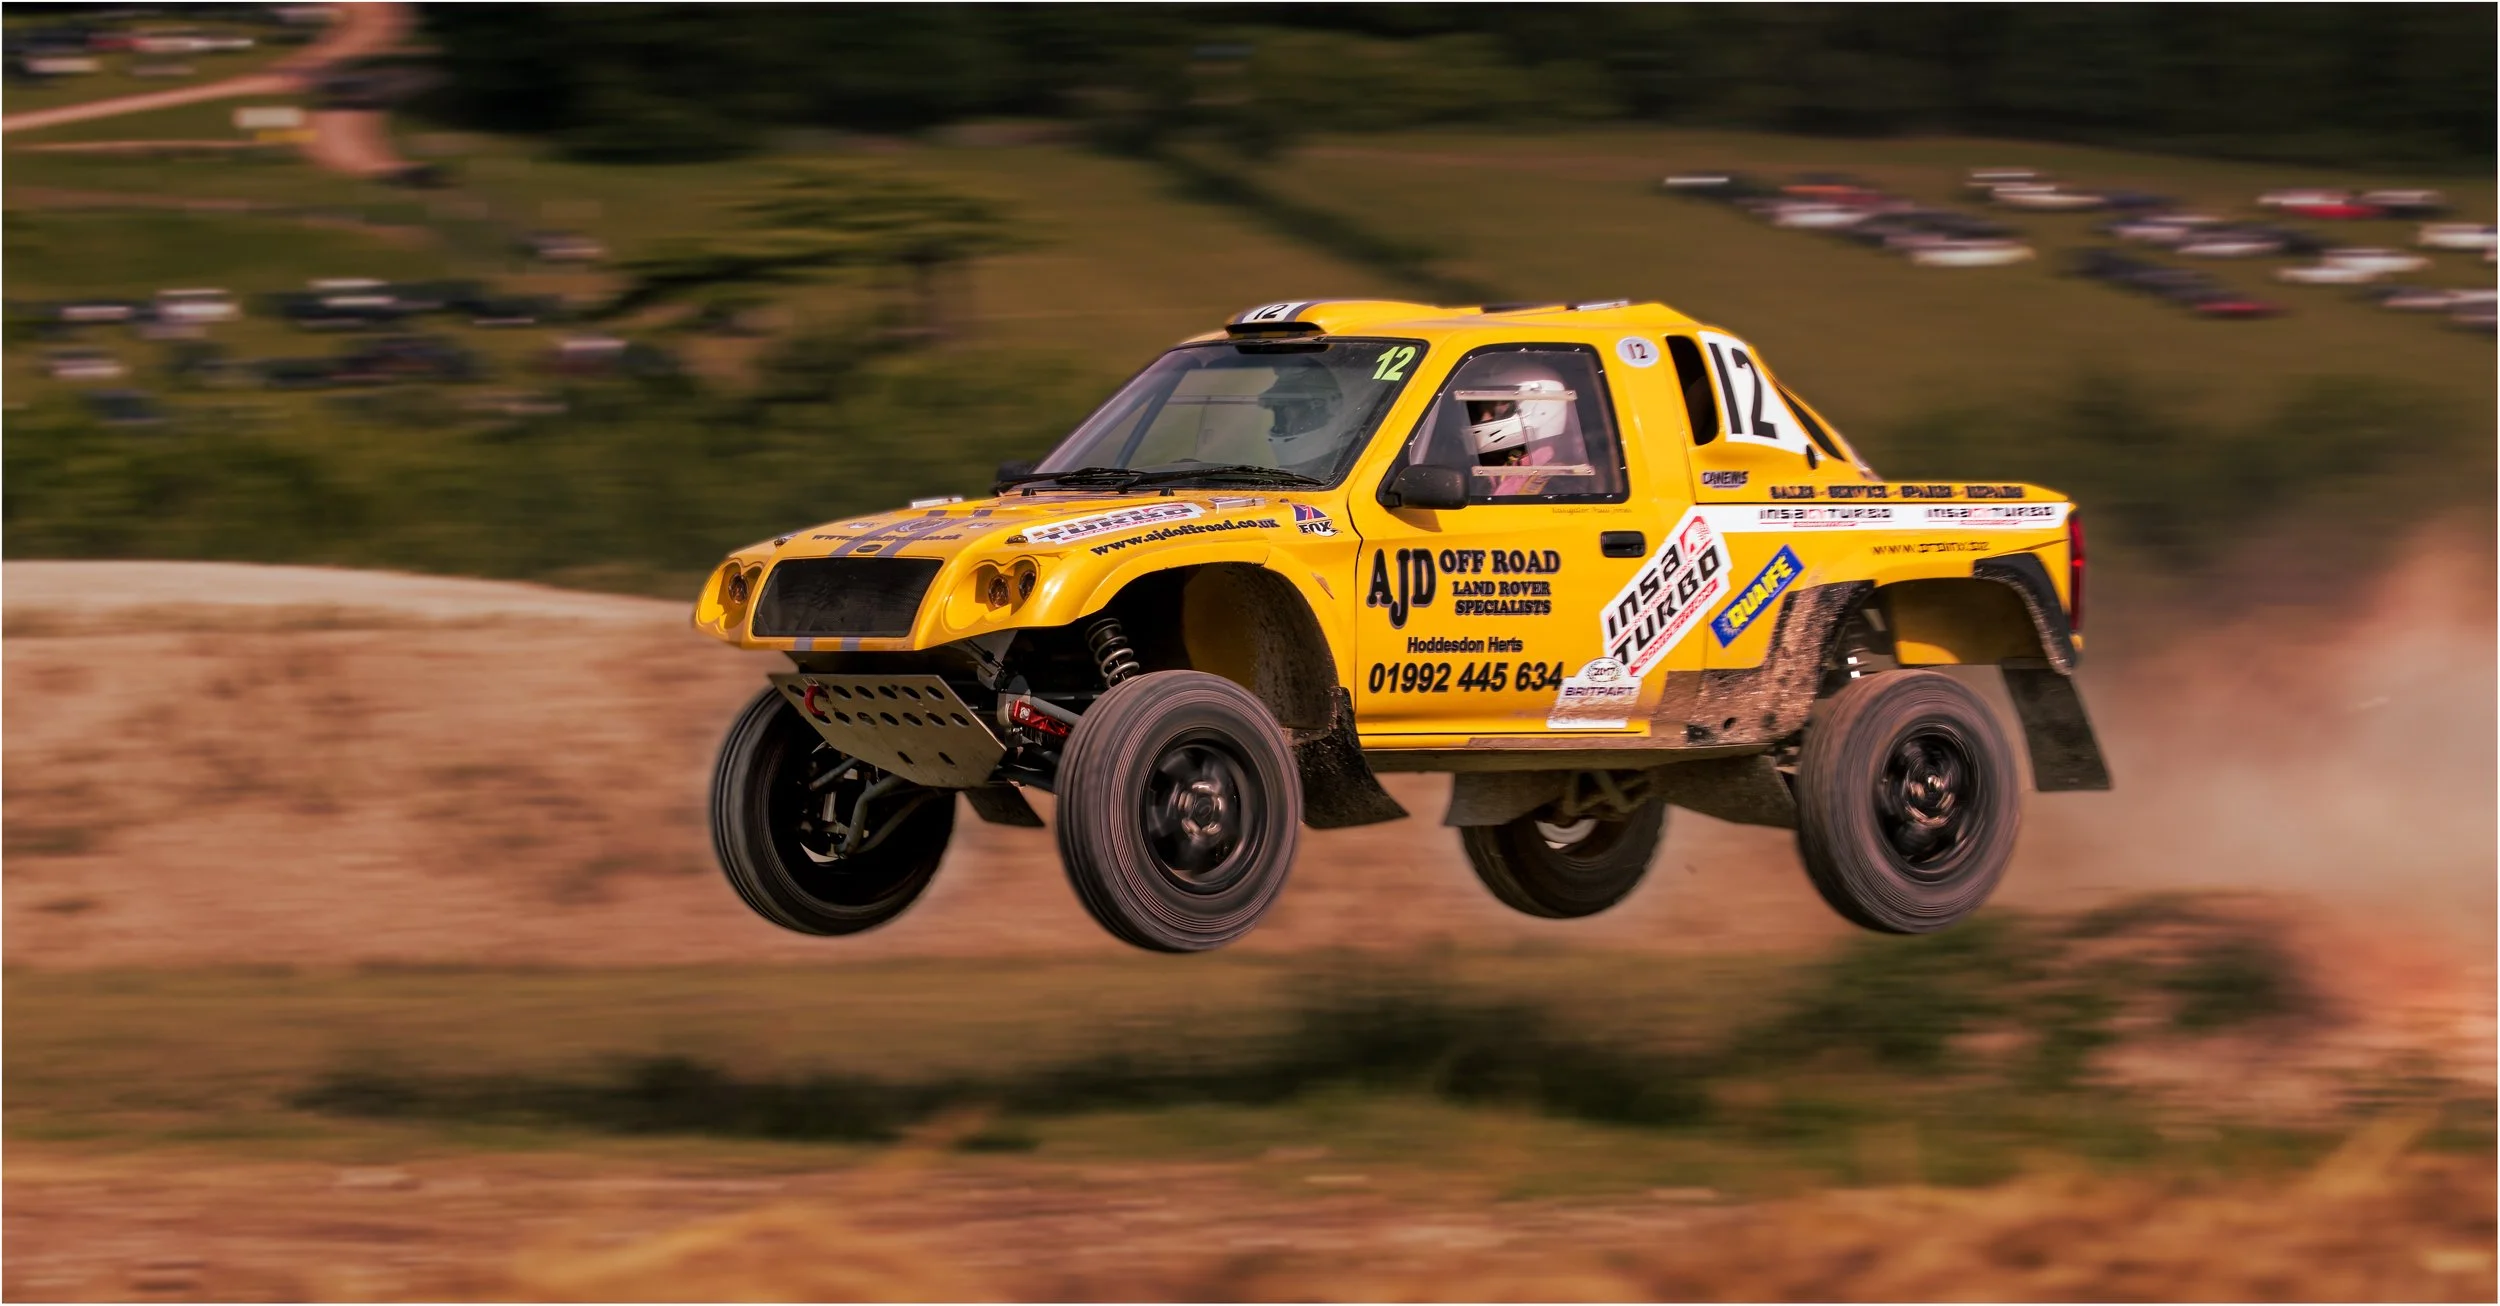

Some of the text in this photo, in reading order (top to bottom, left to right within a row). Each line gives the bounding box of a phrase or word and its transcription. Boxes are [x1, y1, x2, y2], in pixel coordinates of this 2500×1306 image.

[1253, 304, 1288, 320] 12
[1627, 343, 1648, 359] 12
[1372, 346, 1416, 381] 12
[1708, 342, 1778, 439] 12
[1299, 521, 1333, 534] FOX
[1366, 548, 1561, 629] AJD OFF ROAD
[1452, 581, 1552, 596] LAND ROVER
[1726, 555, 1793, 629] QUAIFE
[1455, 599, 1552, 615] SPECIALISTS
[1613, 545, 1721, 665] TURBO
[1407, 637, 1523, 653] Hoddesdon Herts
[1368, 661, 1564, 693] 01992 445 634
[1565, 686, 1635, 696] BRITPART
